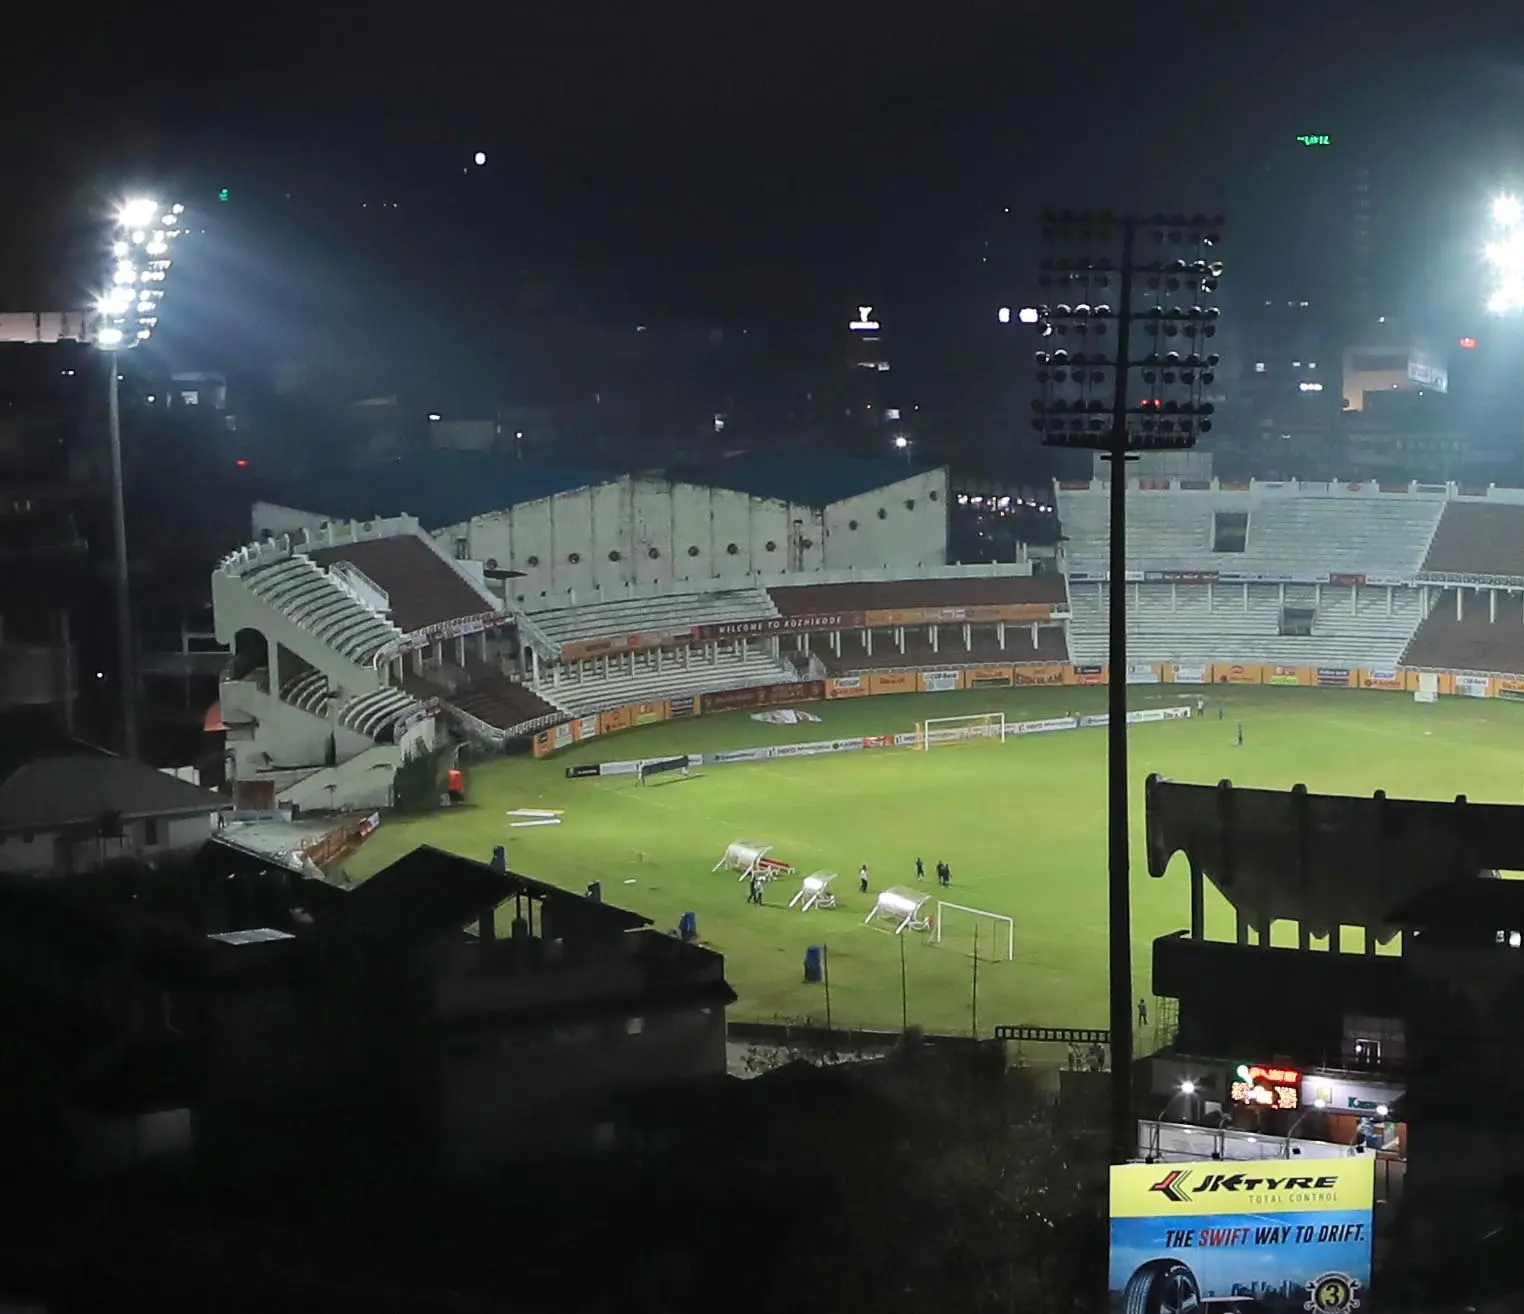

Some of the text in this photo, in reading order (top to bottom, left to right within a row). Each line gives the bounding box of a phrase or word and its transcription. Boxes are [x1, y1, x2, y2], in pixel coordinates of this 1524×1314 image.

[767, 620, 780, 629] TO
[784, 616, 842, 628] KOZHIKODE
[1250, 1193, 1338, 1205] TOTAL CONTROL
[1165, 1223, 1365, 1248] THE SWIFT WAY TO DRIFT.
[1325, 1284, 1340, 1306] 3
